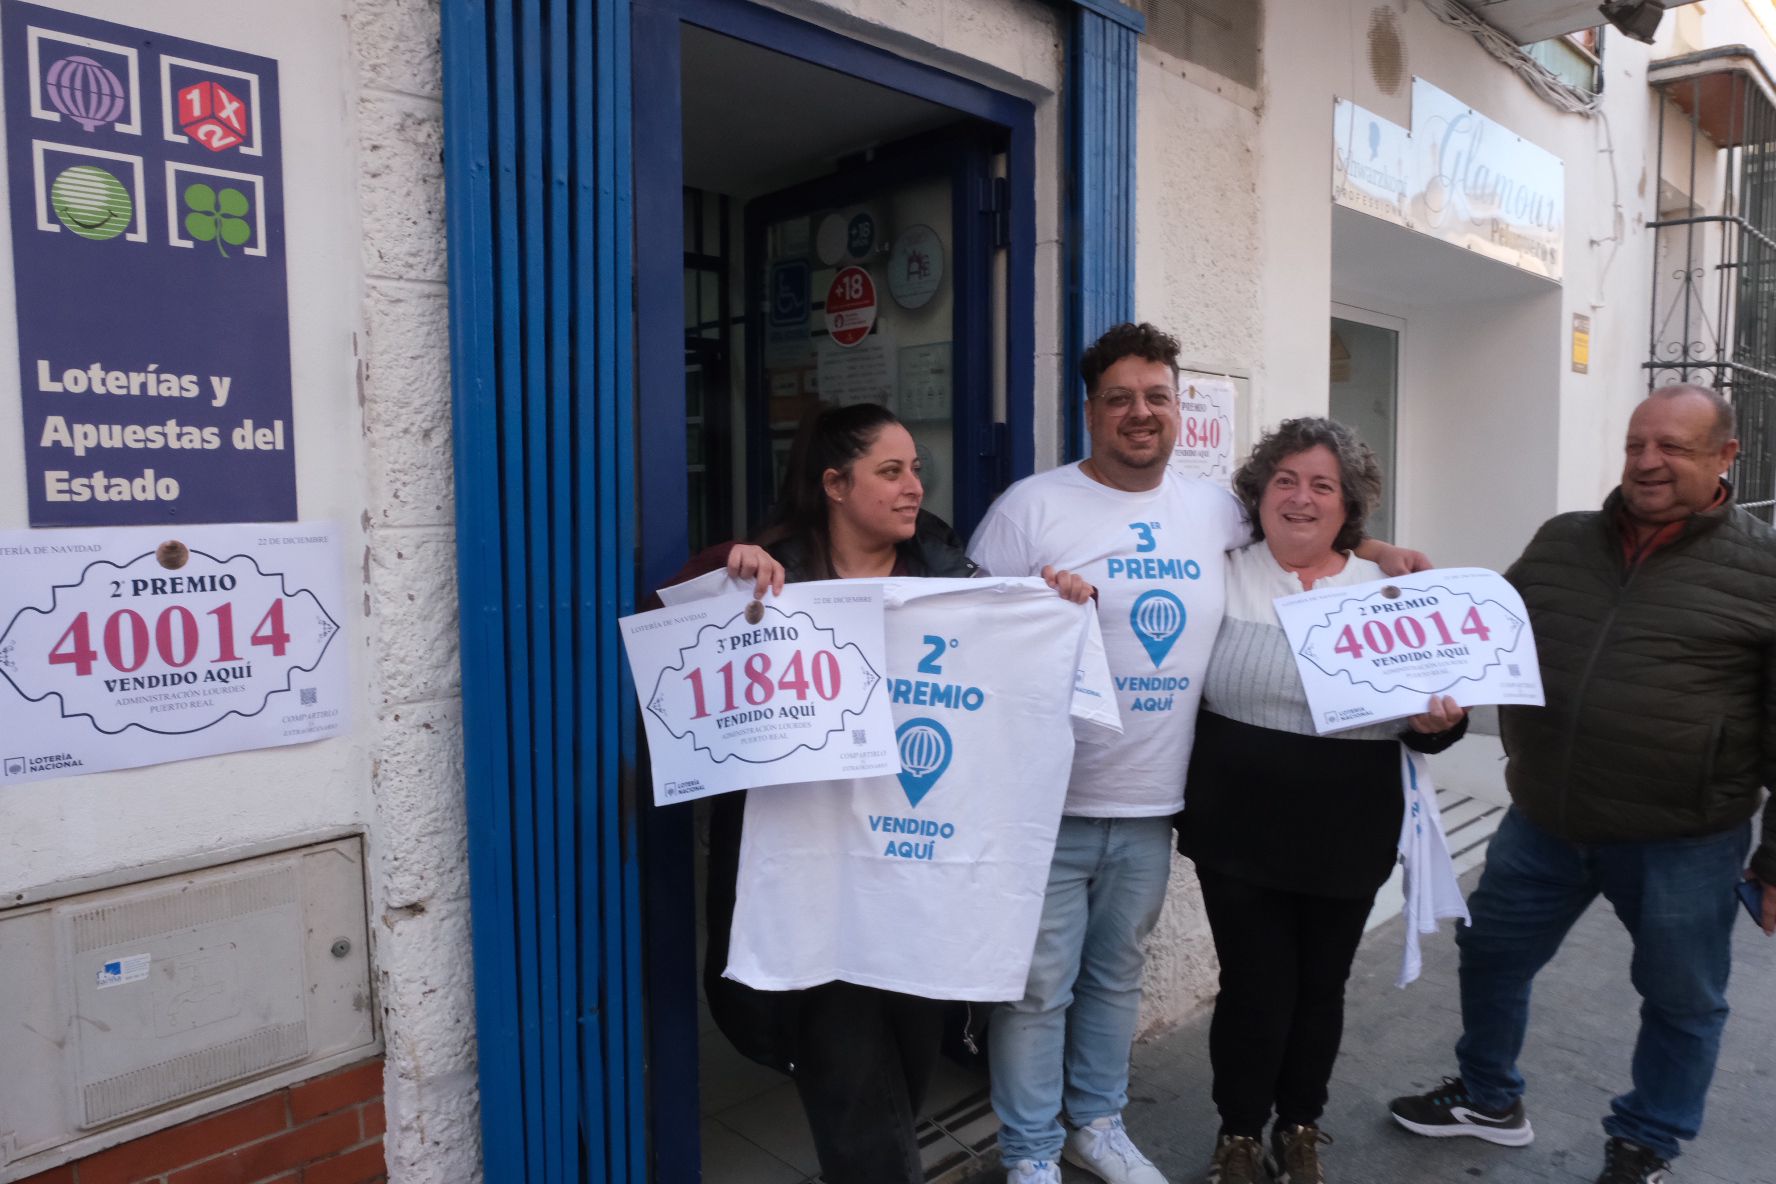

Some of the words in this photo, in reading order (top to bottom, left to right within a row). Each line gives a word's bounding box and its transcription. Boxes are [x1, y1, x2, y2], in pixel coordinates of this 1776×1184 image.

[1423, 113, 1556, 232] Glamour
[835, 273, 863, 300] +18
[37, 360, 200, 397] Loterías
[210, 374, 231, 407] y
[40, 416, 220, 457] Apuestas
[232, 419, 285, 451] del
[1176, 416, 1220, 448] 1840
[45, 469, 180, 502] Estado
[0, 545, 31, 556] TERÍA
[33, 546, 49, 555] DE
[50, 543, 102, 554] NAVIDAD
[269, 537, 281, 545] DE
[283, 535, 329, 545] DICIEMBRE
[1107, 557, 1201, 580] PREMIO
[131, 573, 238, 597] PREMIO
[1371, 596, 1440, 615] PREMIO
[48, 598, 291, 677] 40014
[730, 626, 799, 650] PREMIO
[1334, 605, 1491, 659] 40014
[1371, 650, 1433, 667] VENDIDO
[104, 671, 198, 693] VENDIDO
[203, 661, 253, 684] AQUÍ
[683, 649, 842, 720] 11840
[1115, 676, 1190, 692] VENDIDO
[114, 688, 201, 707] ADMINISTRACIÓN
[202, 684, 246, 697] LOURDES
[149, 701, 188, 713] PUERTO
[190, 699, 215, 710] REAL
[1130, 693, 1174, 712] AQUÍ
[716, 708, 774, 729] VENDIDO
[779, 701, 816, 720] AQUÍ
[29, 752, 73, 765] LOTERÍA
[30, 759, 84, 773] NACIONAL
[868, 815, 955, 840] VENDIDO
[884, 840, 935, 861] AQUÍ
